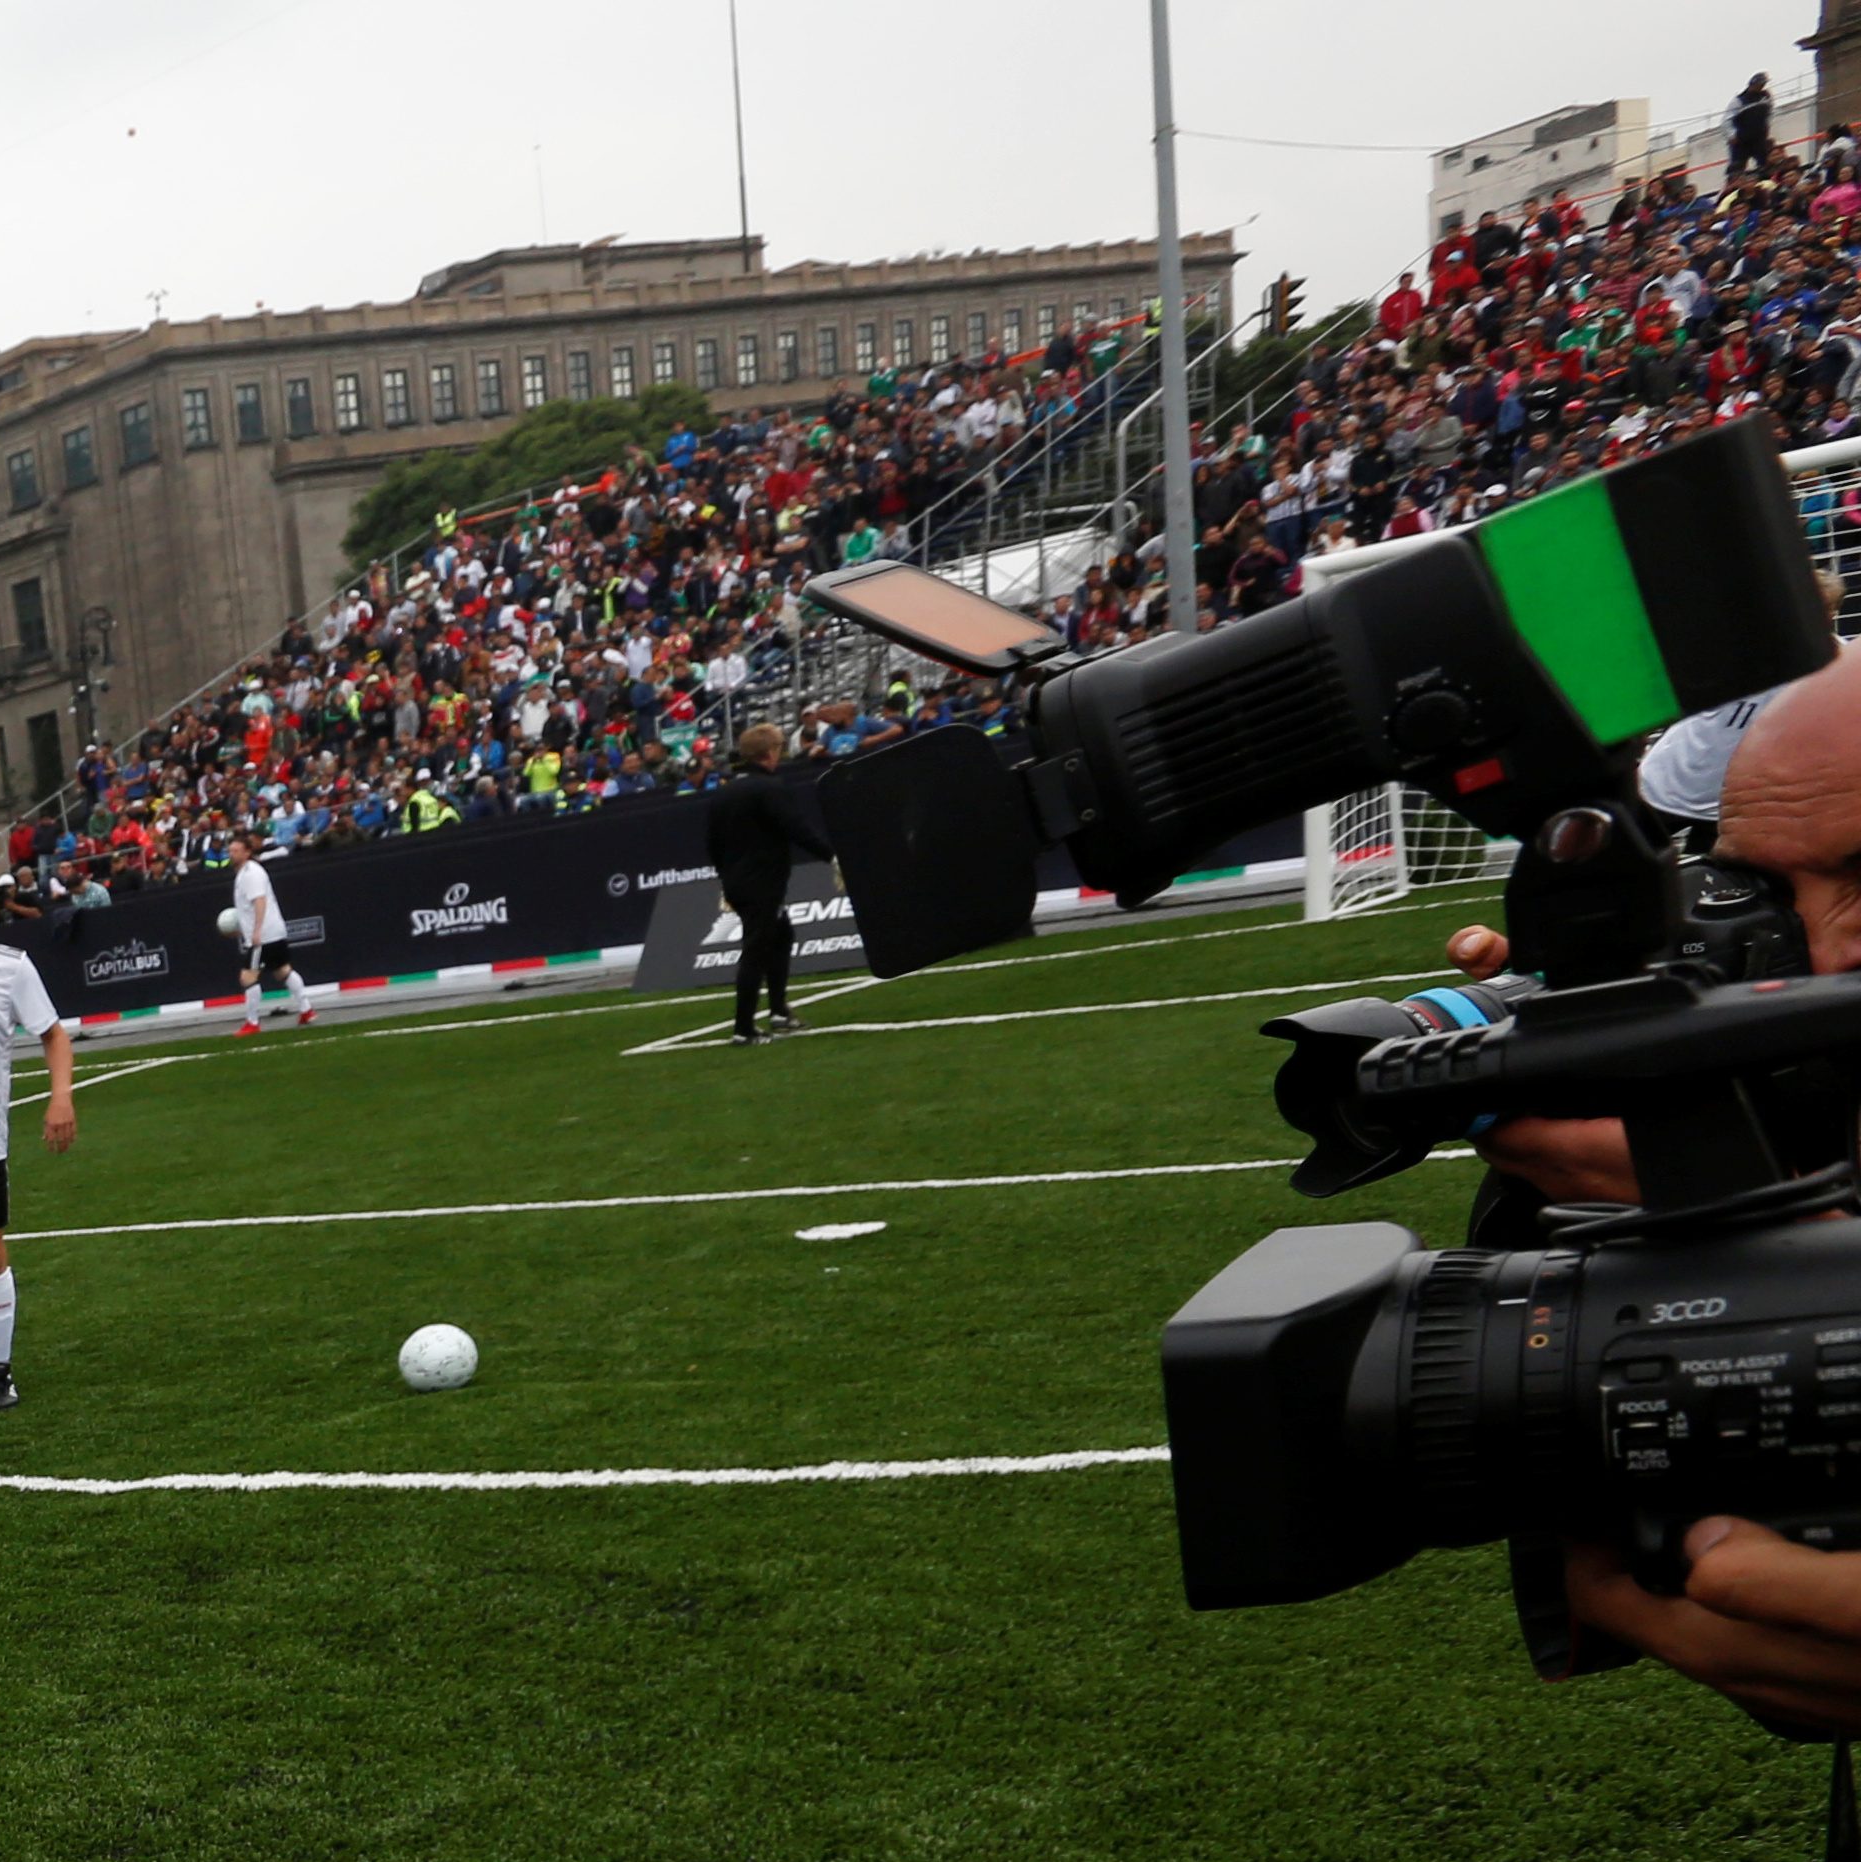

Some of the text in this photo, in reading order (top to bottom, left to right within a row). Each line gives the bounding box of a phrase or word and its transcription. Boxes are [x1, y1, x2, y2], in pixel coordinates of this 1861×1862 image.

[410, 896, 508, 937] SPALDING
[1682, 942, 1705, 954] EOS
[89, 953, 161, 978] CAPITALBUS
[1648, 1297, 1726, 1324] 3CCD
[1679, 1353, 1789, 1374] FOCUS ASSIST
[1694, 1370, 1773, 1388] ND FILTER
[1618, 1399, 1669, 1414] FOCUS
[1628, 1449, 1668, 1461] PUSH
[1627, 1459, 1671, 1472] AUTO
